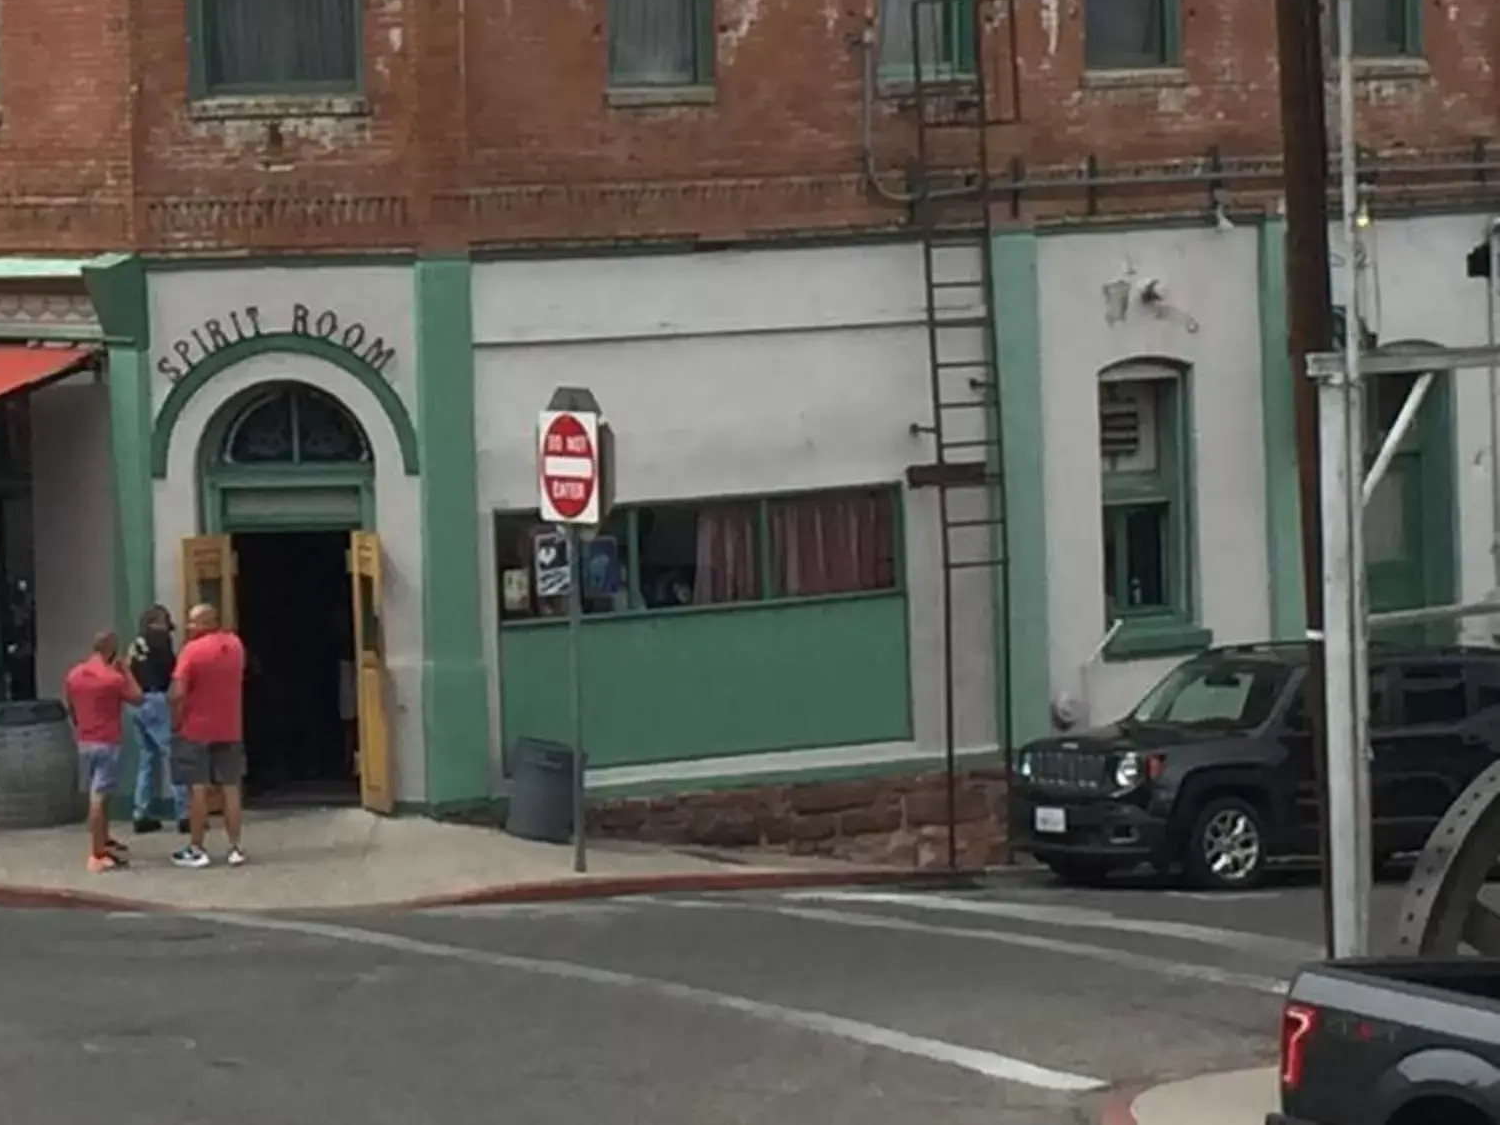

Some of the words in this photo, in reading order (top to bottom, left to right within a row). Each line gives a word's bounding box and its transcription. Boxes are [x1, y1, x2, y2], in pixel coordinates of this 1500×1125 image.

[156, 305, 261, 385] SPIRIT
[292, 302, 396, 372] ROOM
[548, 433, 563, 452] DO
[566, 433, 587, 453] NOT
